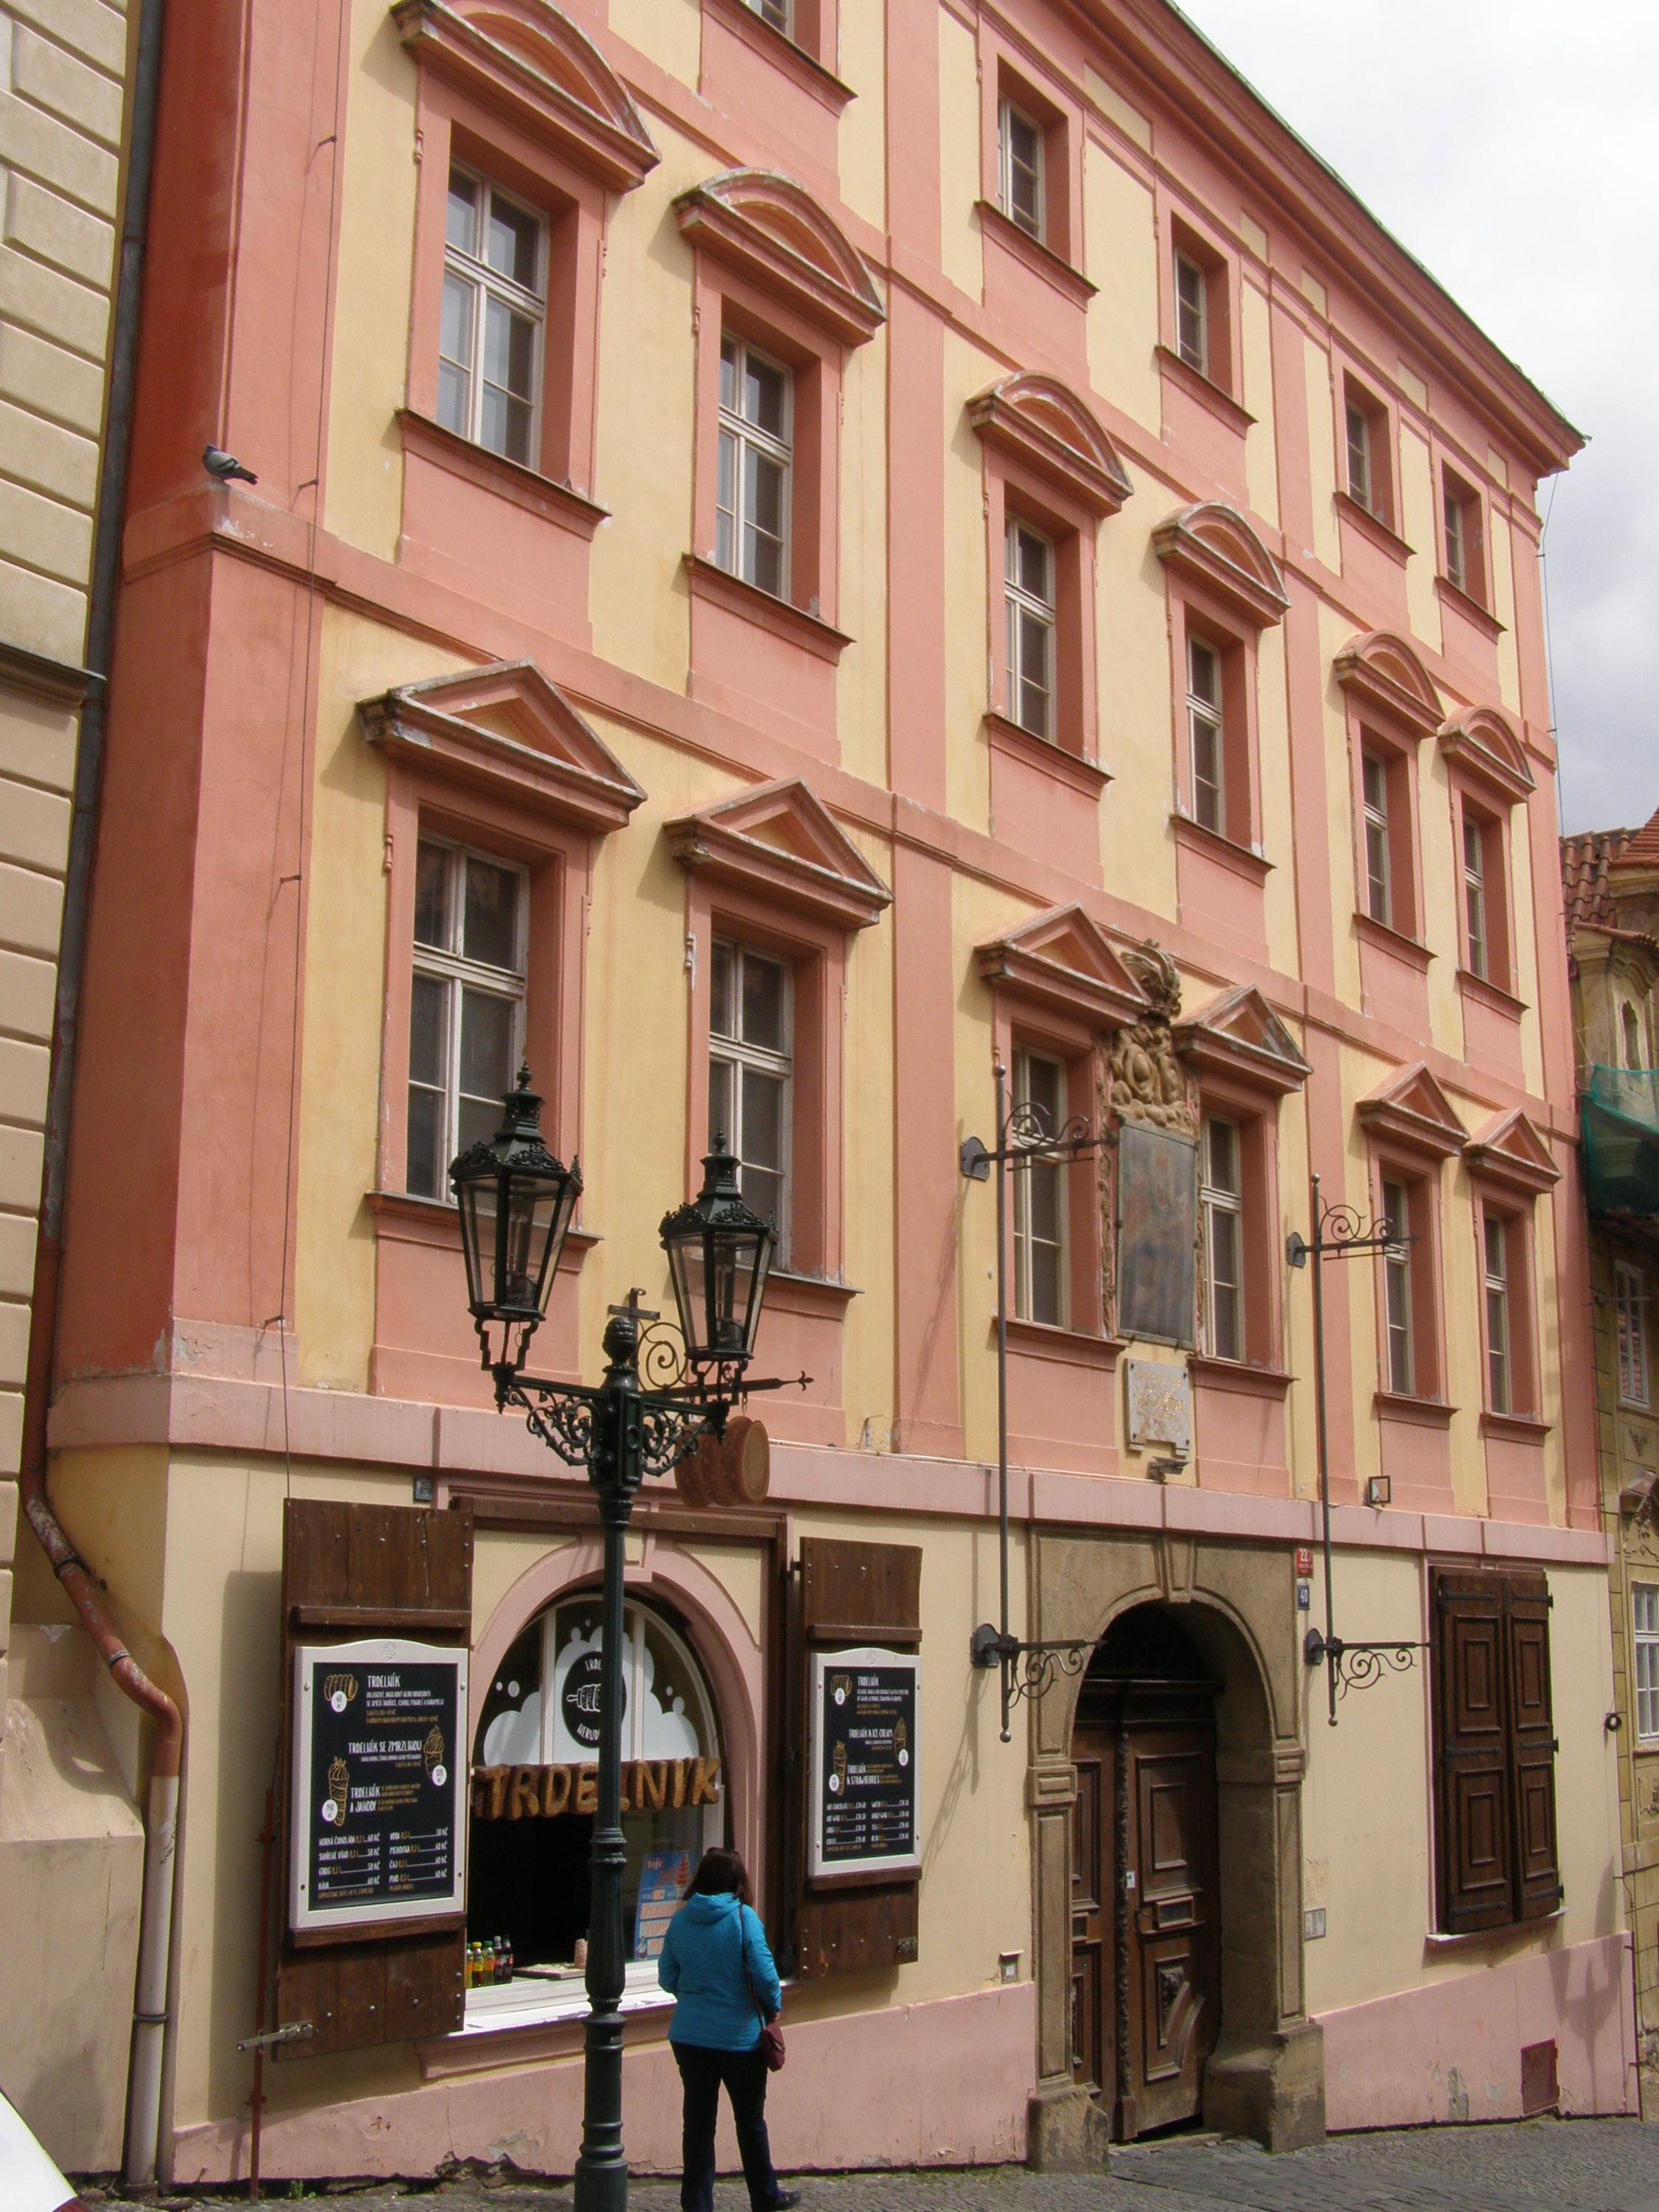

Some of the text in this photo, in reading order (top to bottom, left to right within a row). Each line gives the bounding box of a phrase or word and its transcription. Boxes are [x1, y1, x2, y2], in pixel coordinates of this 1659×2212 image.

[367, 1672, 400, 1688] TRDELNÍK
[348, 1739, 422, 1754] TRDELNÍK SE ZMRZLINOU
[350, 1783, 380, 1798] TRDELNÍK
[349, 1803, 354, 1813] A
[355, 1800, 377, 1812] JAHODY
